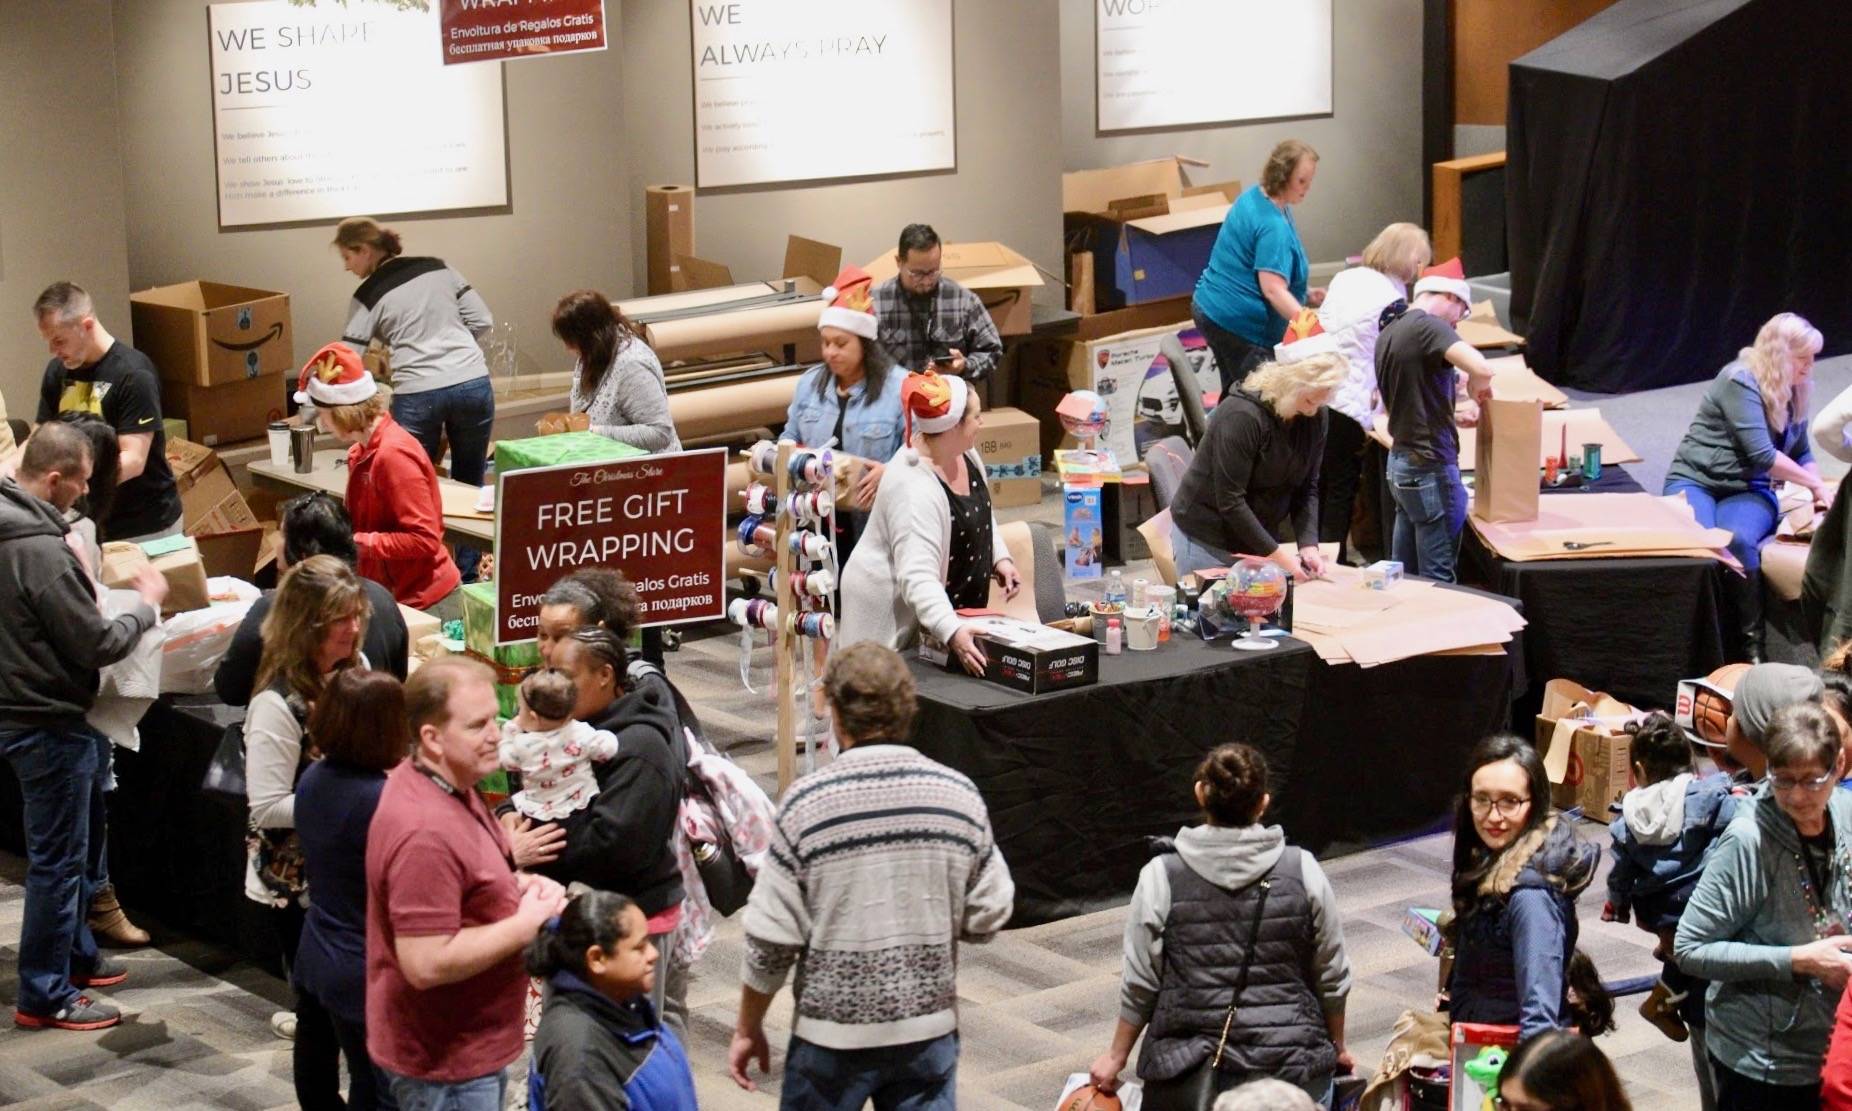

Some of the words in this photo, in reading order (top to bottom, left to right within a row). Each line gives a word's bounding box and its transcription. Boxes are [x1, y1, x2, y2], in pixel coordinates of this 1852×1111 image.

[698, 3, 742, 26] WE
[451, 24, 501, 39] Envoltura
[503, 22, 518, 33] de
[519, 17, 561, 32] Regalos
[563, 14, 594, 27] Gratis
[217, 27, 266, 52] WE
[449, 39, 505, 56] бесплатная
[506, 35, 551, 52] упаковка
[553, 31, 598, 45] подарков
[700, 39, 809, 67] ALWAYS
[220, 69, 312, 95] JESUS
[238, 155, 252, 164] tell
[253, 154, 278, 164] others
[569, 472, 592, 487] The
[635, 464, 664, 479] Store
[537, 497, 613, 530] FREE
[623, 489, 689, 520] GIFT
[526, 528, 695, 571] WRAPPING
[634, 577, 665, 593] alos
[668, 571, 710, 589] Gratis
[651, 594, 713, 611] подарков
[1001, 655, 1018, 668] GOLF
[1017, 659, 1032, 671] DISC
[1048, 659, 1067, 670] GOLF
[1068, 655, 1085, 666] DISC
